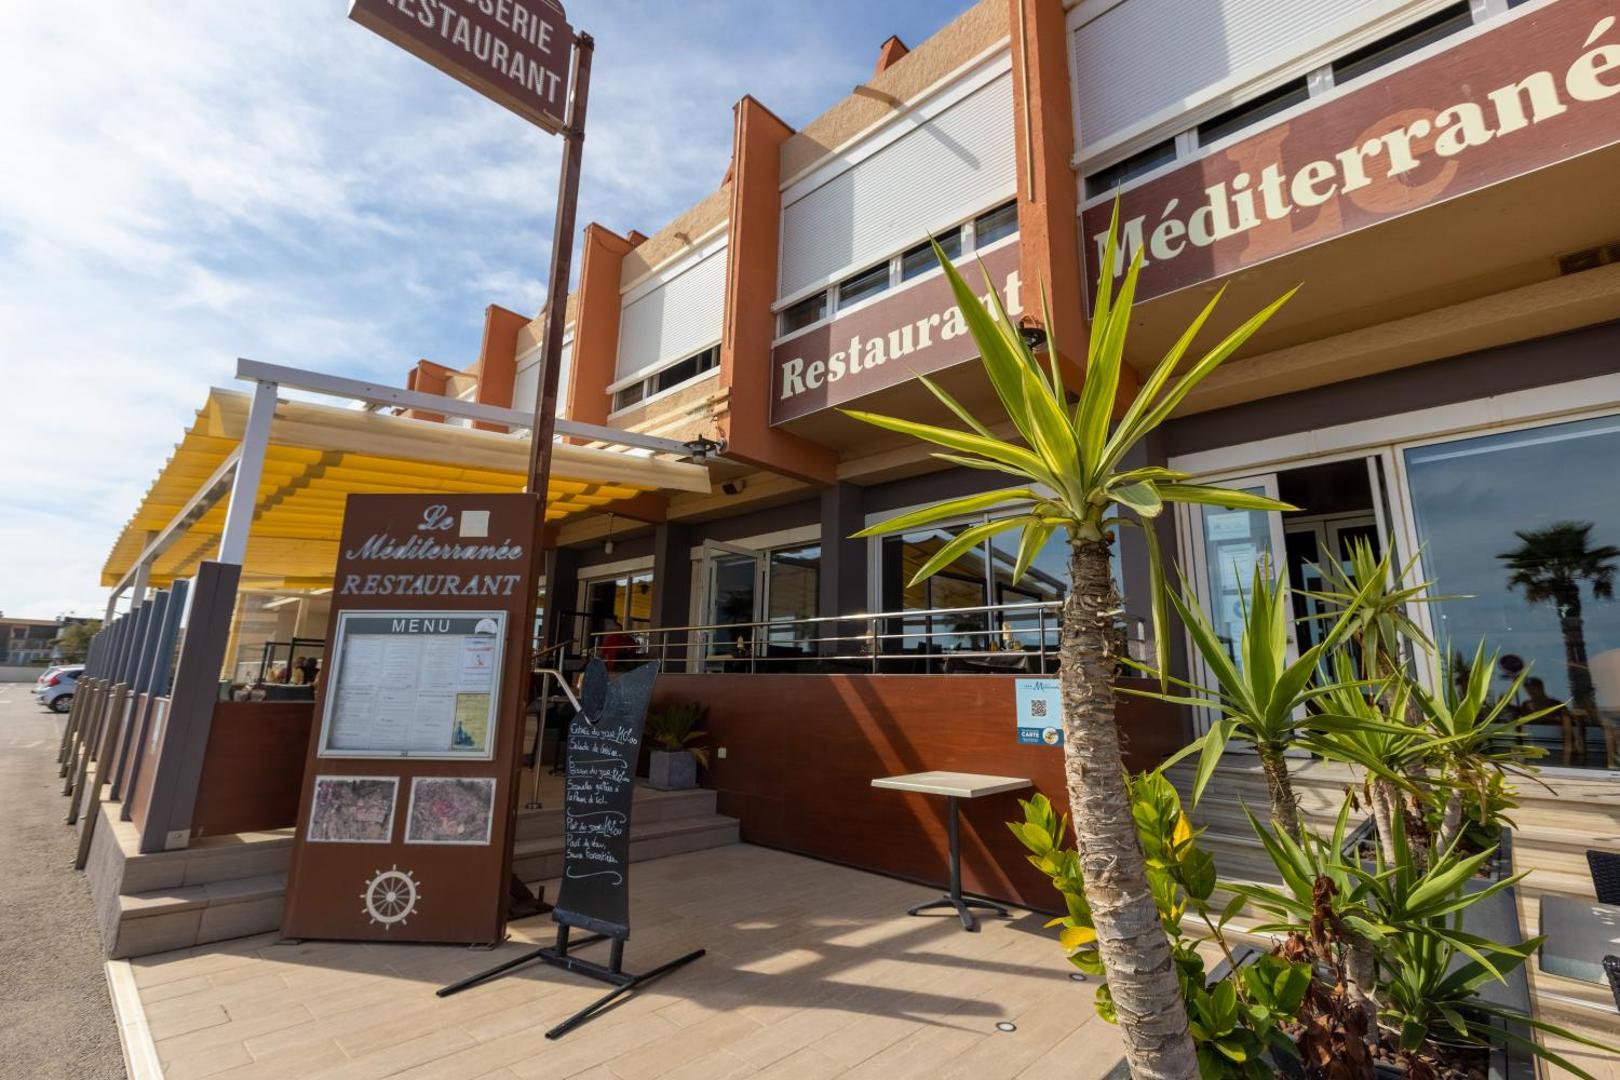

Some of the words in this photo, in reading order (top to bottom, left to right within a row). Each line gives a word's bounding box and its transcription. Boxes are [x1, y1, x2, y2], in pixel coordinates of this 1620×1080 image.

[465, 0, 554, 54] SERIE
[386, 0, 561, 103] ESTAURANT
[418, 504, 455, 531] Le
[346, 533, 524, 561] Méditerranée
[340, 574, 522, 596] RESTAURANT
[391, 618, 451, 633] MENU
